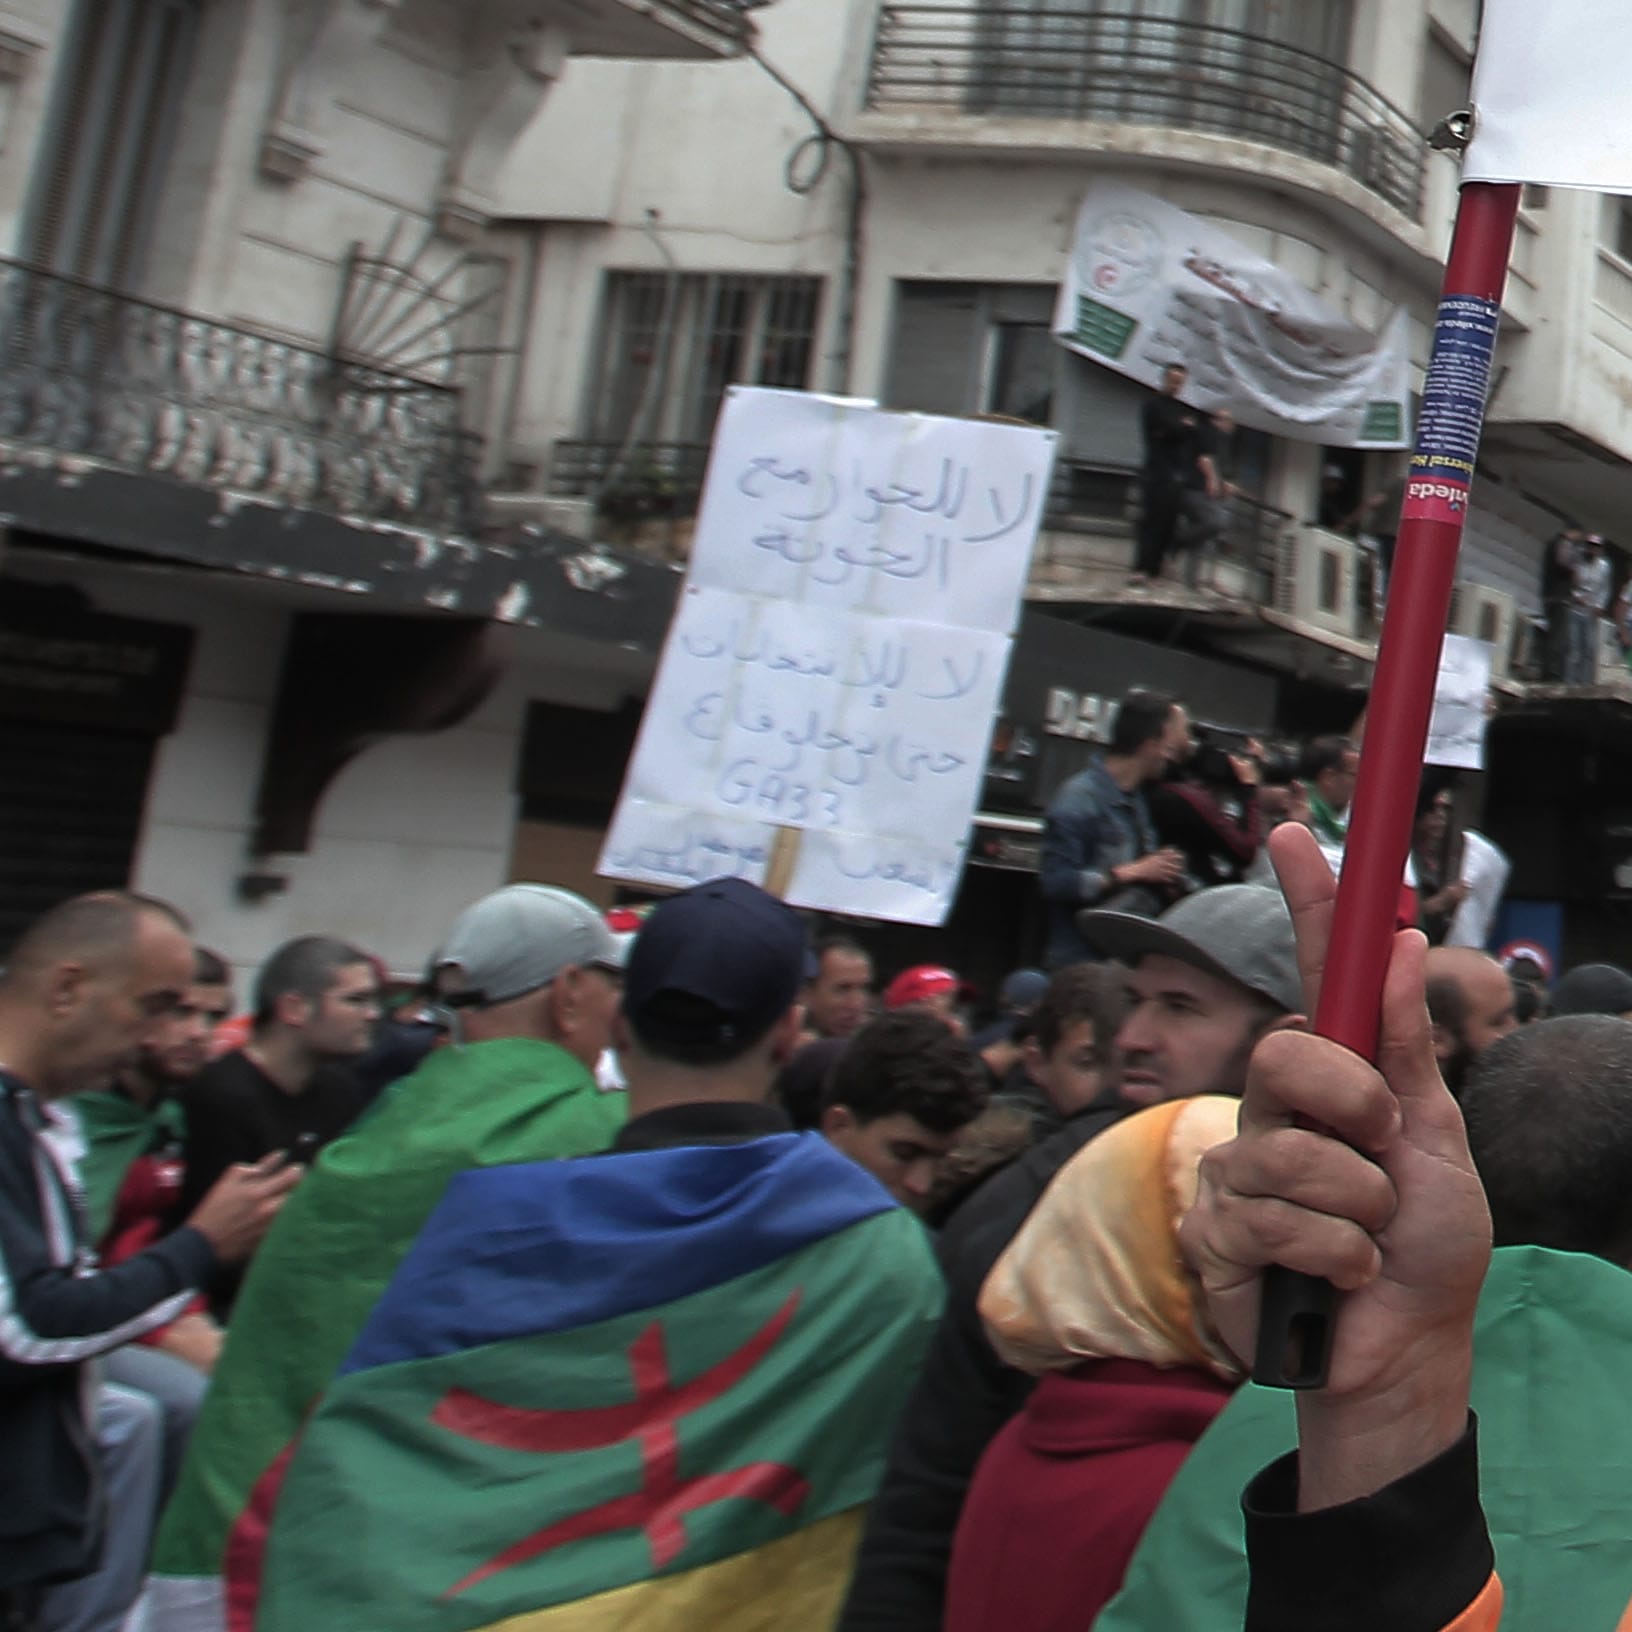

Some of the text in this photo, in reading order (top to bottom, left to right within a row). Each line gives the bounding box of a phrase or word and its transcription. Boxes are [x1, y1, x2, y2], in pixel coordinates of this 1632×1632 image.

[737, 457, 811, 499] مع
[962, 472, 1033, 543] لا
[916, 650, 985, 701] لا
